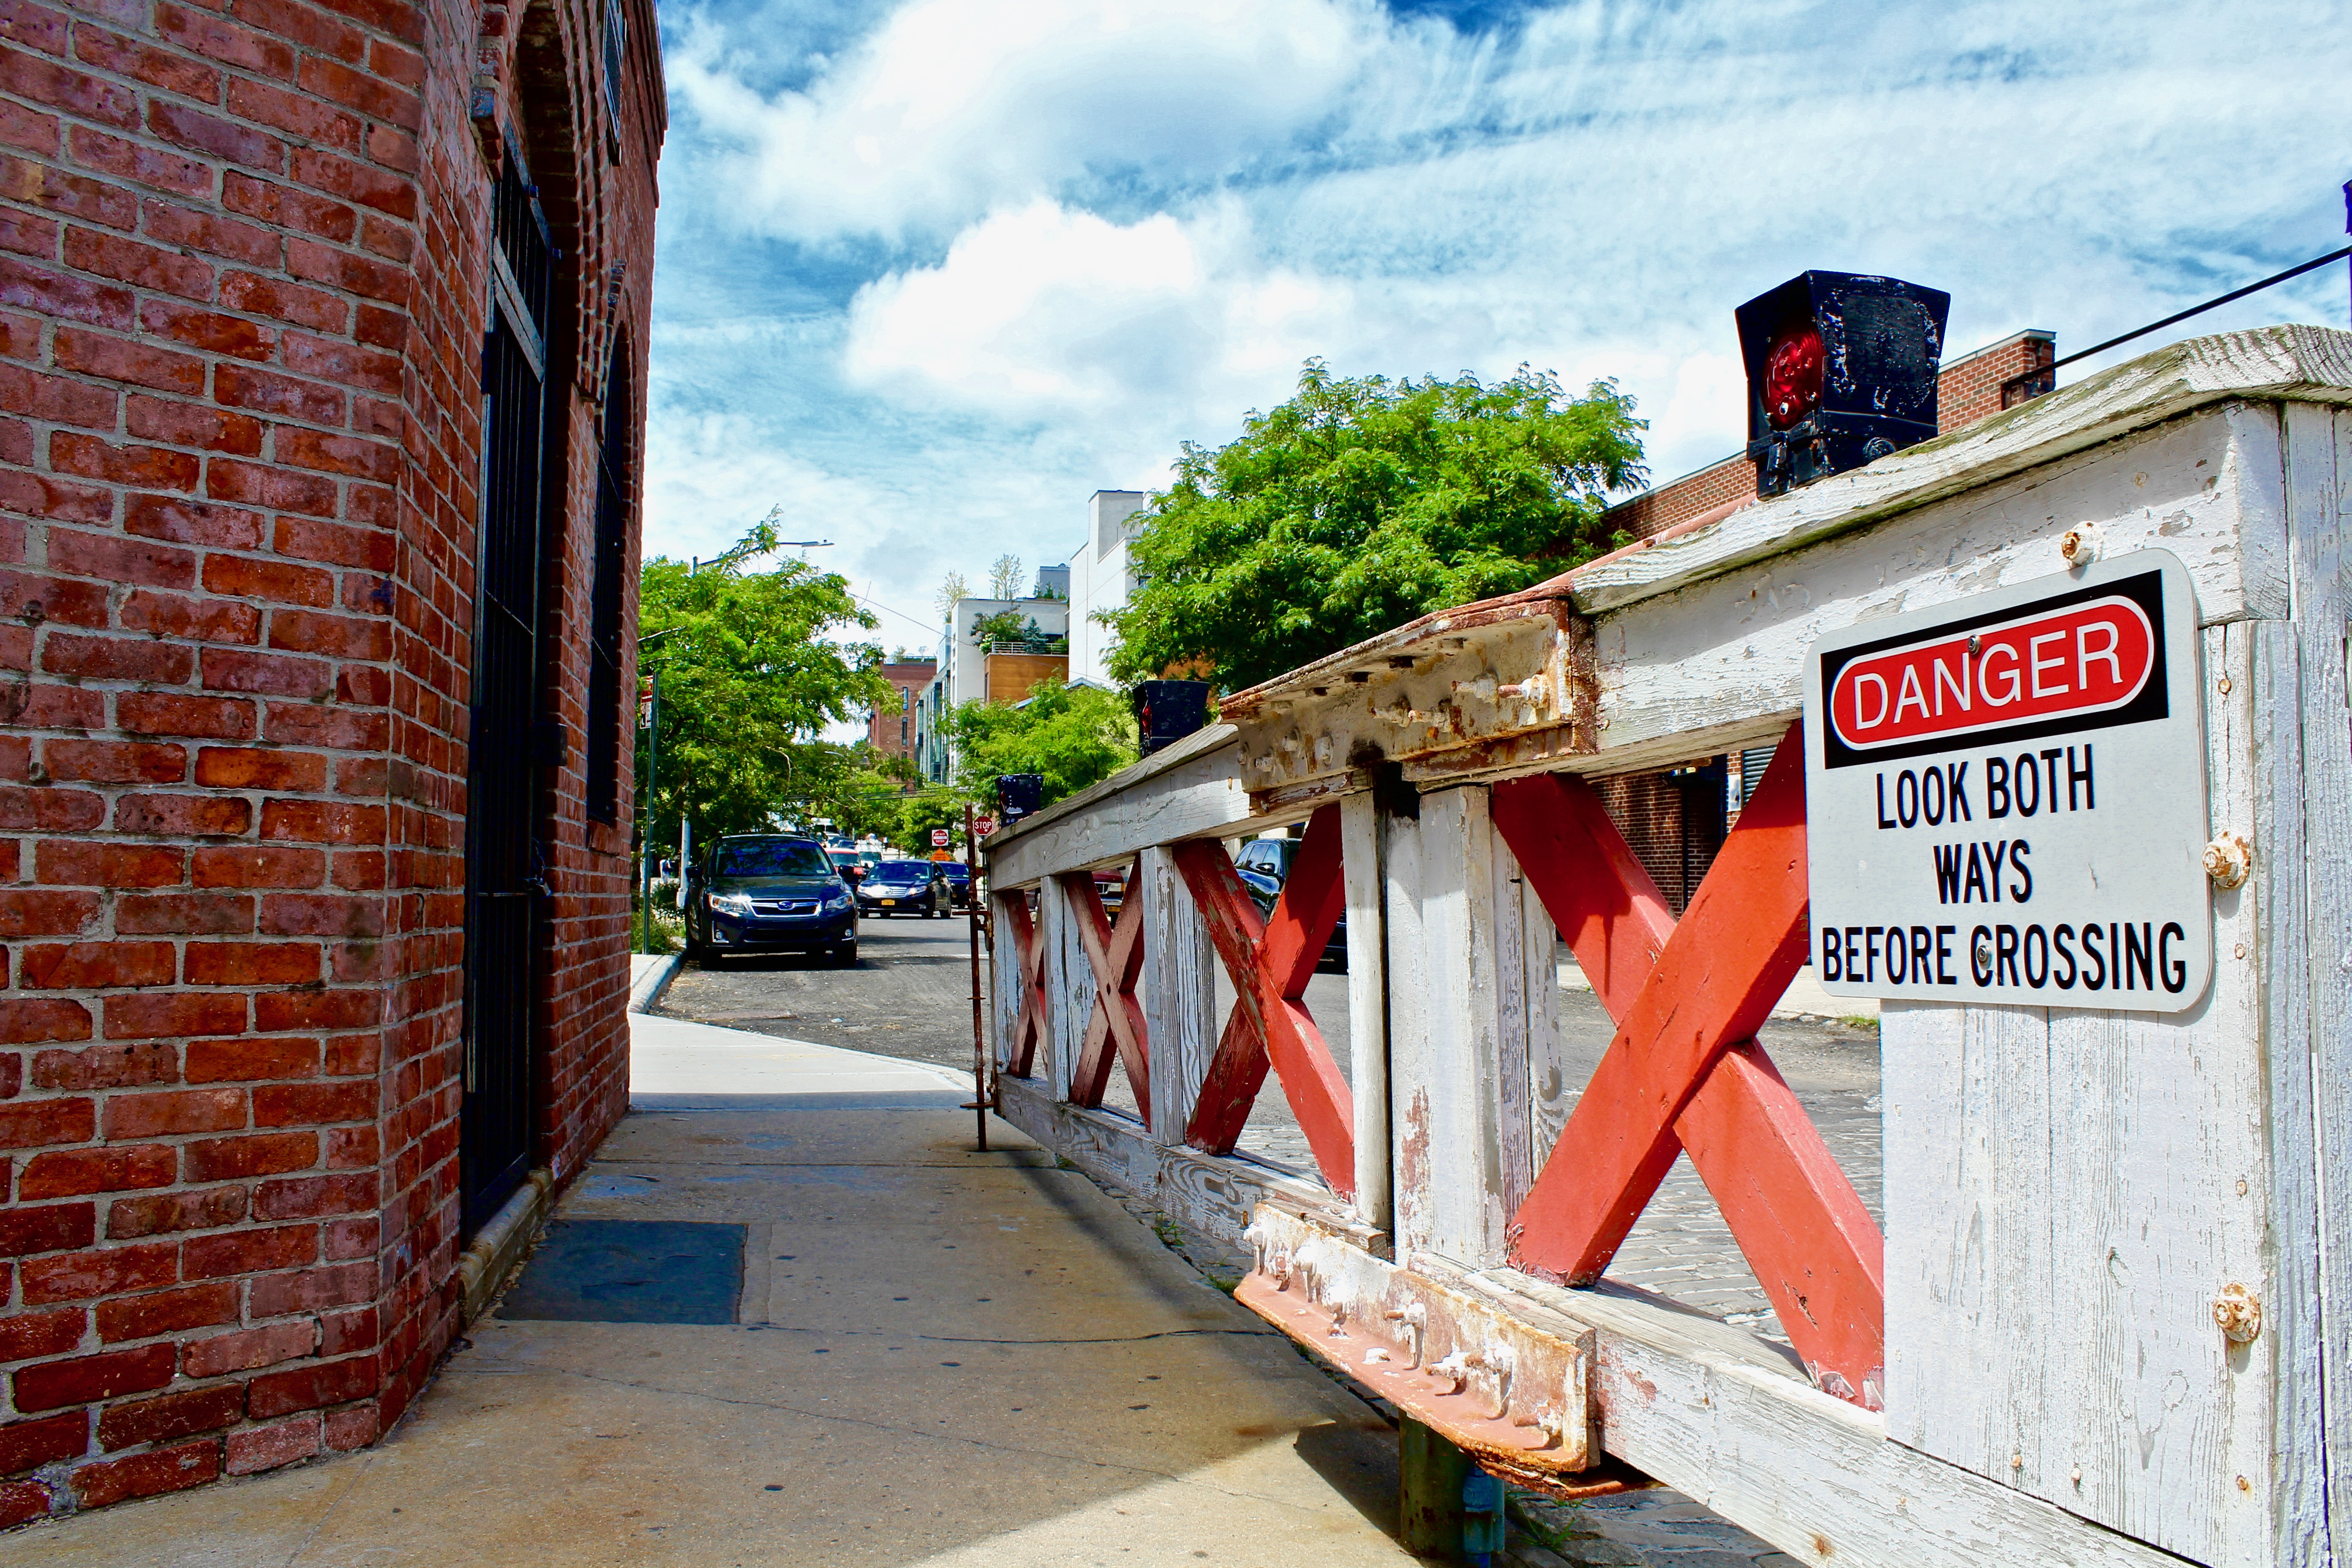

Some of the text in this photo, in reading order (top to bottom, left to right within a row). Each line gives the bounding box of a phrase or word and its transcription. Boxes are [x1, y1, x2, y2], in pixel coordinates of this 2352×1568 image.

[1854, 620, 2123, 730] DANGER
[1876, 743, 2094, 830] LOOK BOTH
[1933, 838, 2031, 904] WAYS
[1822, 921, 2186, 994] BEFORE CROSSING
